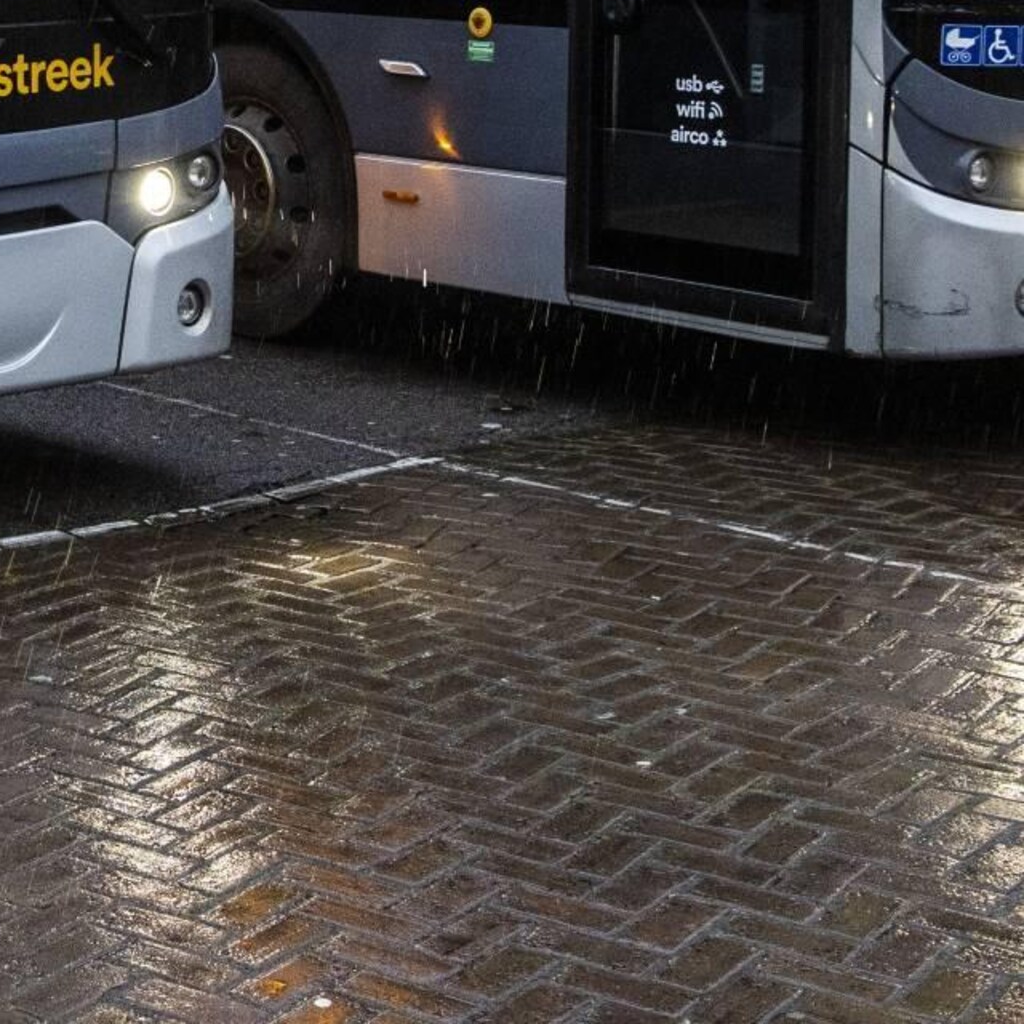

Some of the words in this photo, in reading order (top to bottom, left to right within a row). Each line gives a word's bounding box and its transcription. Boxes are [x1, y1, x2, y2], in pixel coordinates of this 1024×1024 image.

[676, 74, 703, 92] usb
[676, 100, 706, 119] wifi
[671, 124, 709, 145] airco
